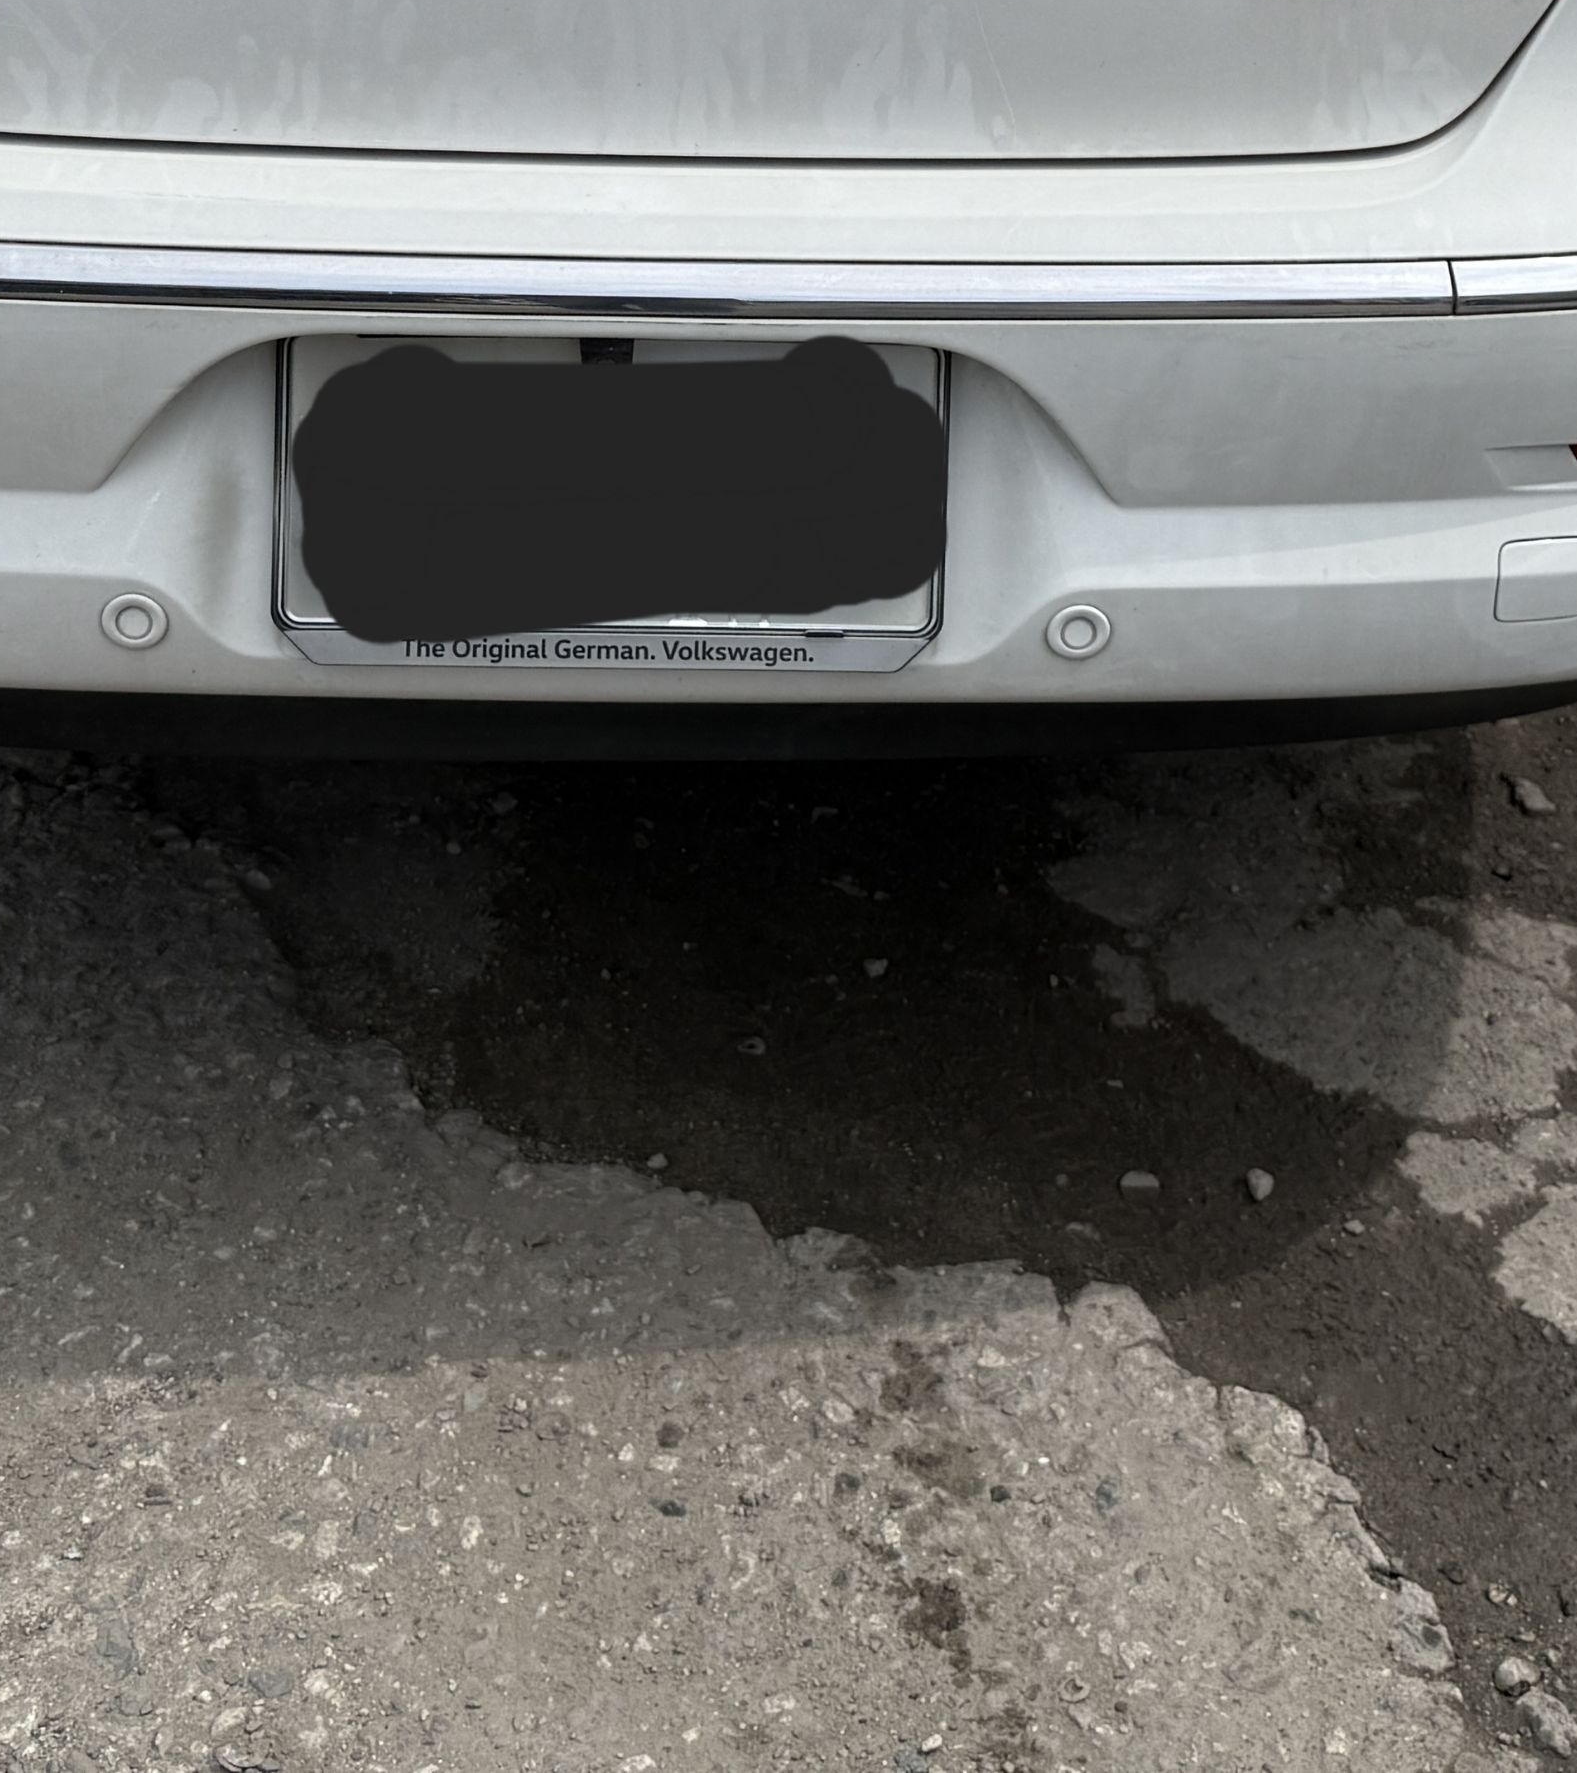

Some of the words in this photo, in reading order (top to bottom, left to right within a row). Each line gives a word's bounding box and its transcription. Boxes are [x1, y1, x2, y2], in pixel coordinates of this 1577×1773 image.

[401, 638, 446, 658] The
[452, 637, 548, 664] Original
[554, 638, 656, 661] German.
[662, 639, 815, 667] Volkswagen.
